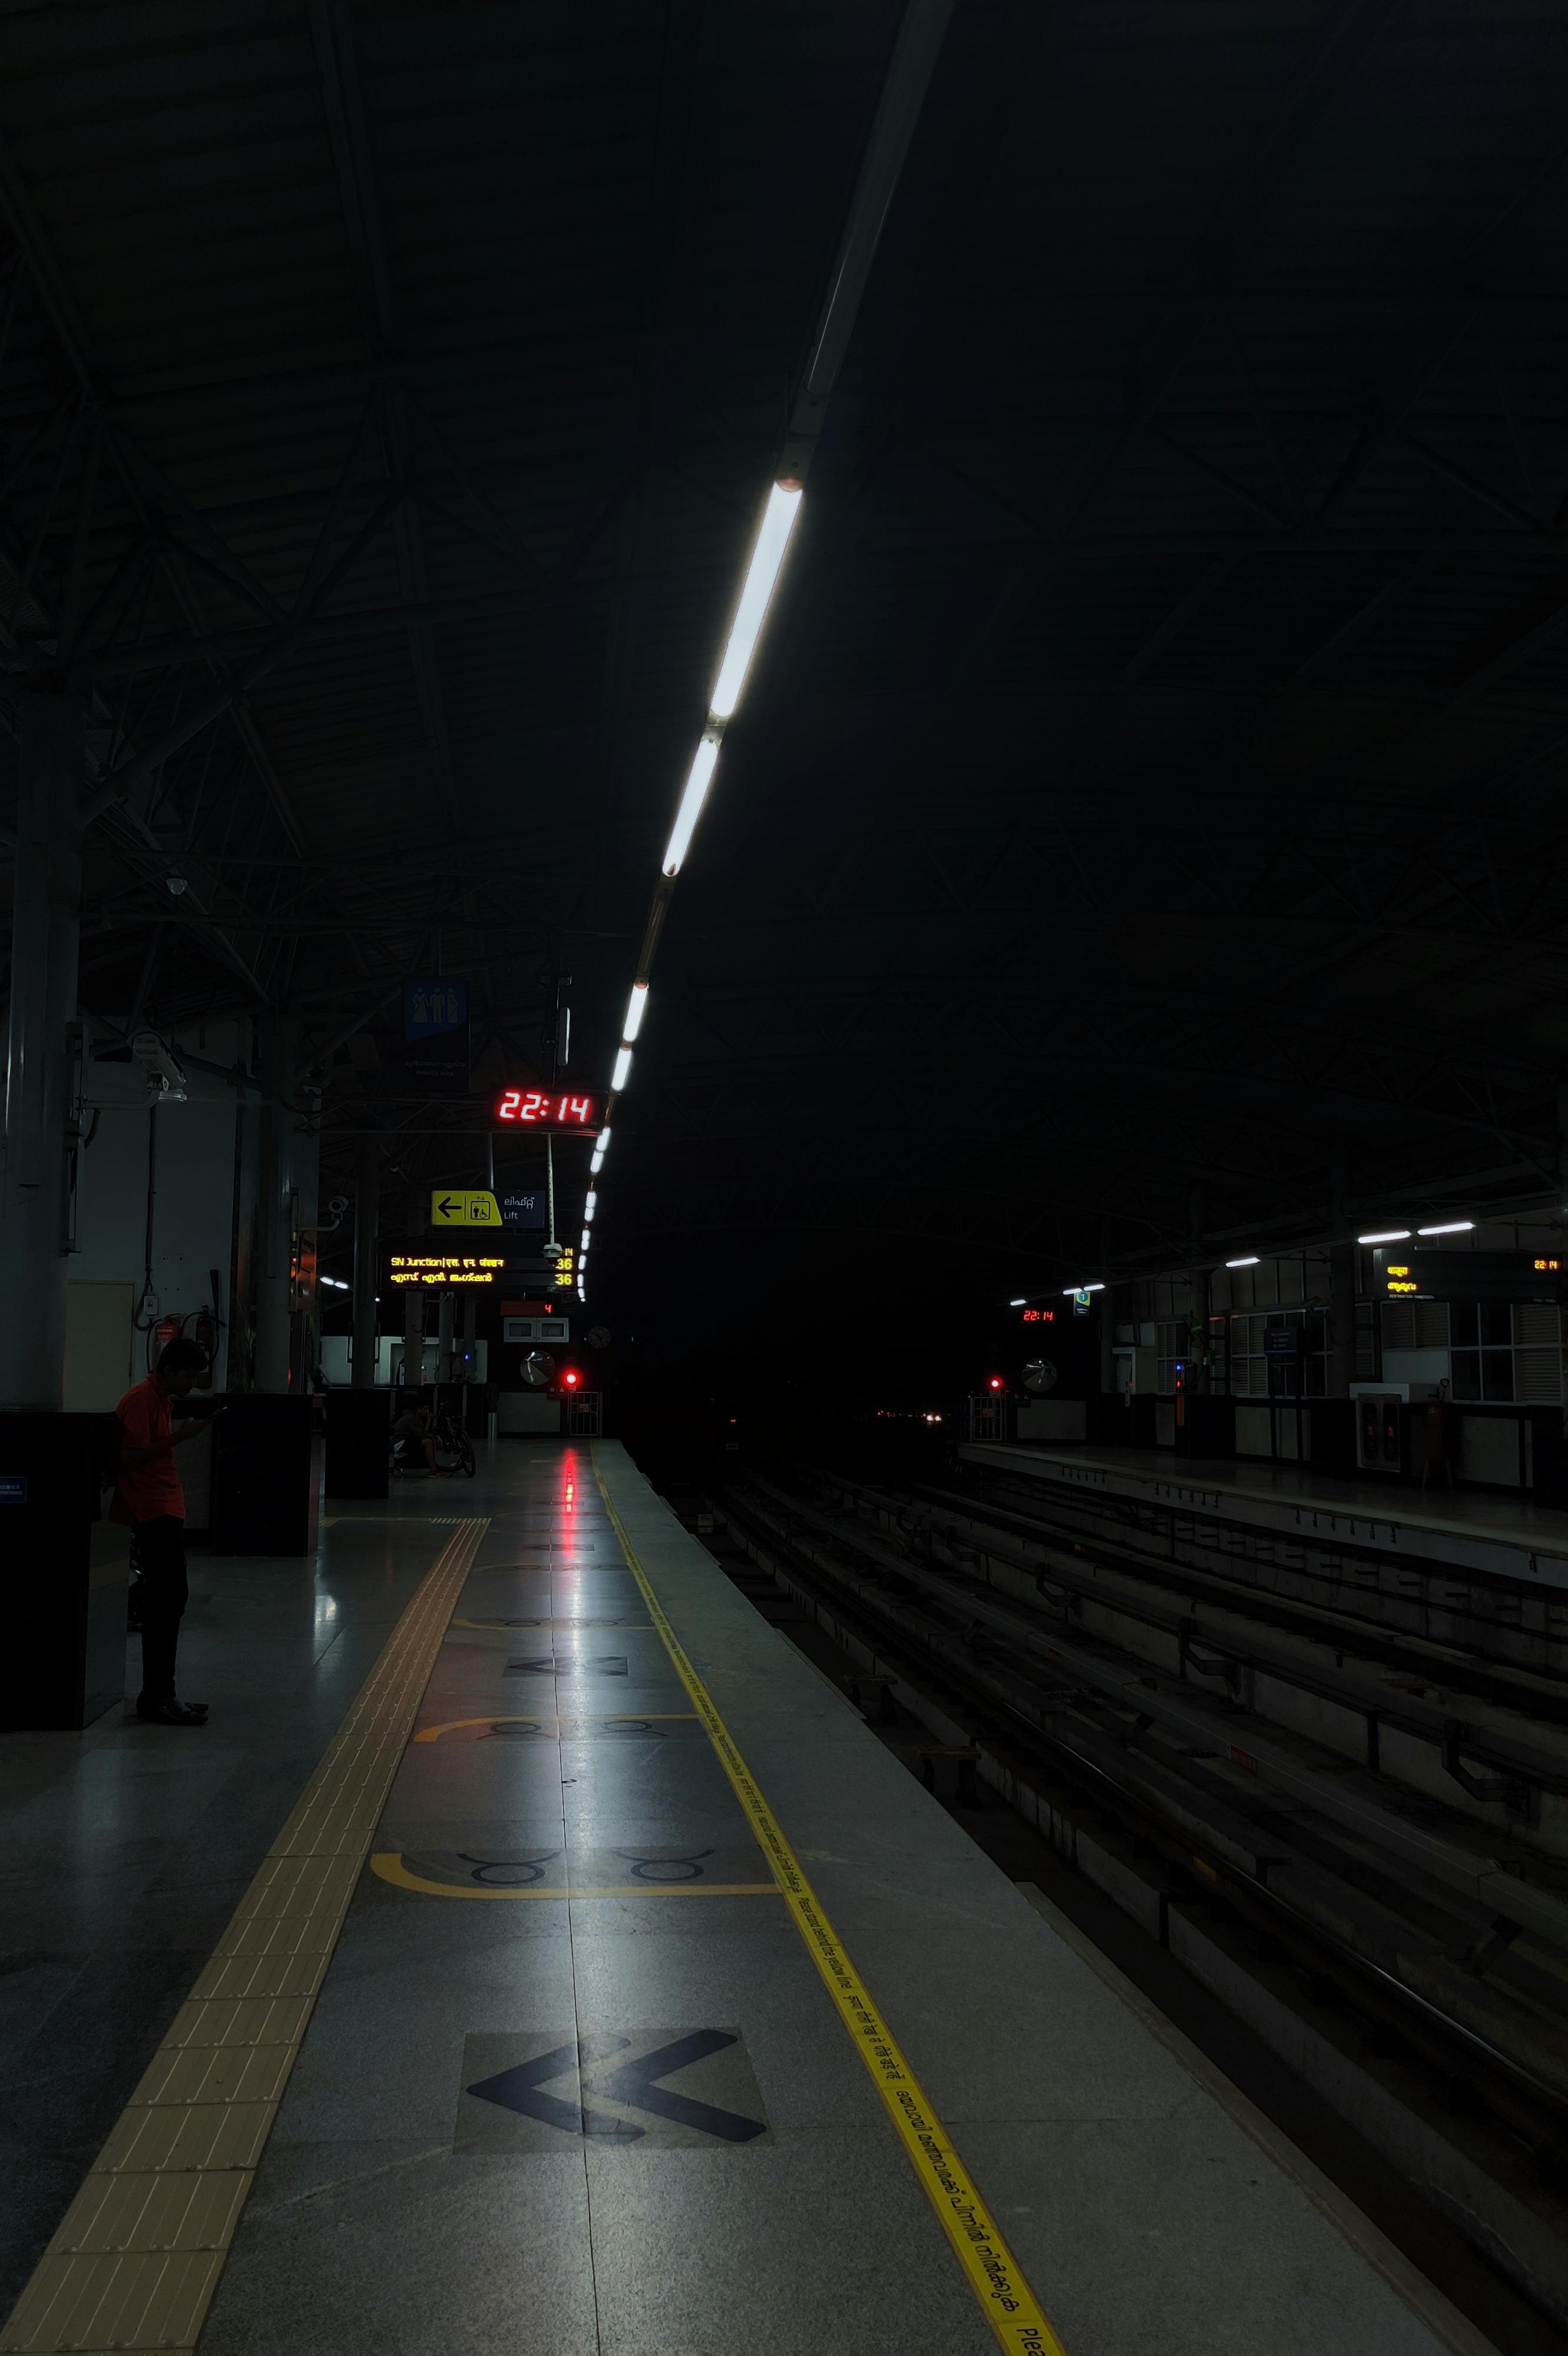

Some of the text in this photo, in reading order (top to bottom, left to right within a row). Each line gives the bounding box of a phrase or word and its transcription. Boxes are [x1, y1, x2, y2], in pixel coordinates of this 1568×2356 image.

[499, 1092, 590, 1121] 22:14
[504, 1211, 519, 1220] Lift
[391, 1258, 405, 1267] SN
[555, 1258, 573, 1270] 36
[554, 1273, 572, 1285] 36
[1024, 1310, 1053, 1321] 22:14
[797, 1897, 852, 1989] Please stand behind the yellow line
[896, 2090, 933, 2131] ദയവായി
